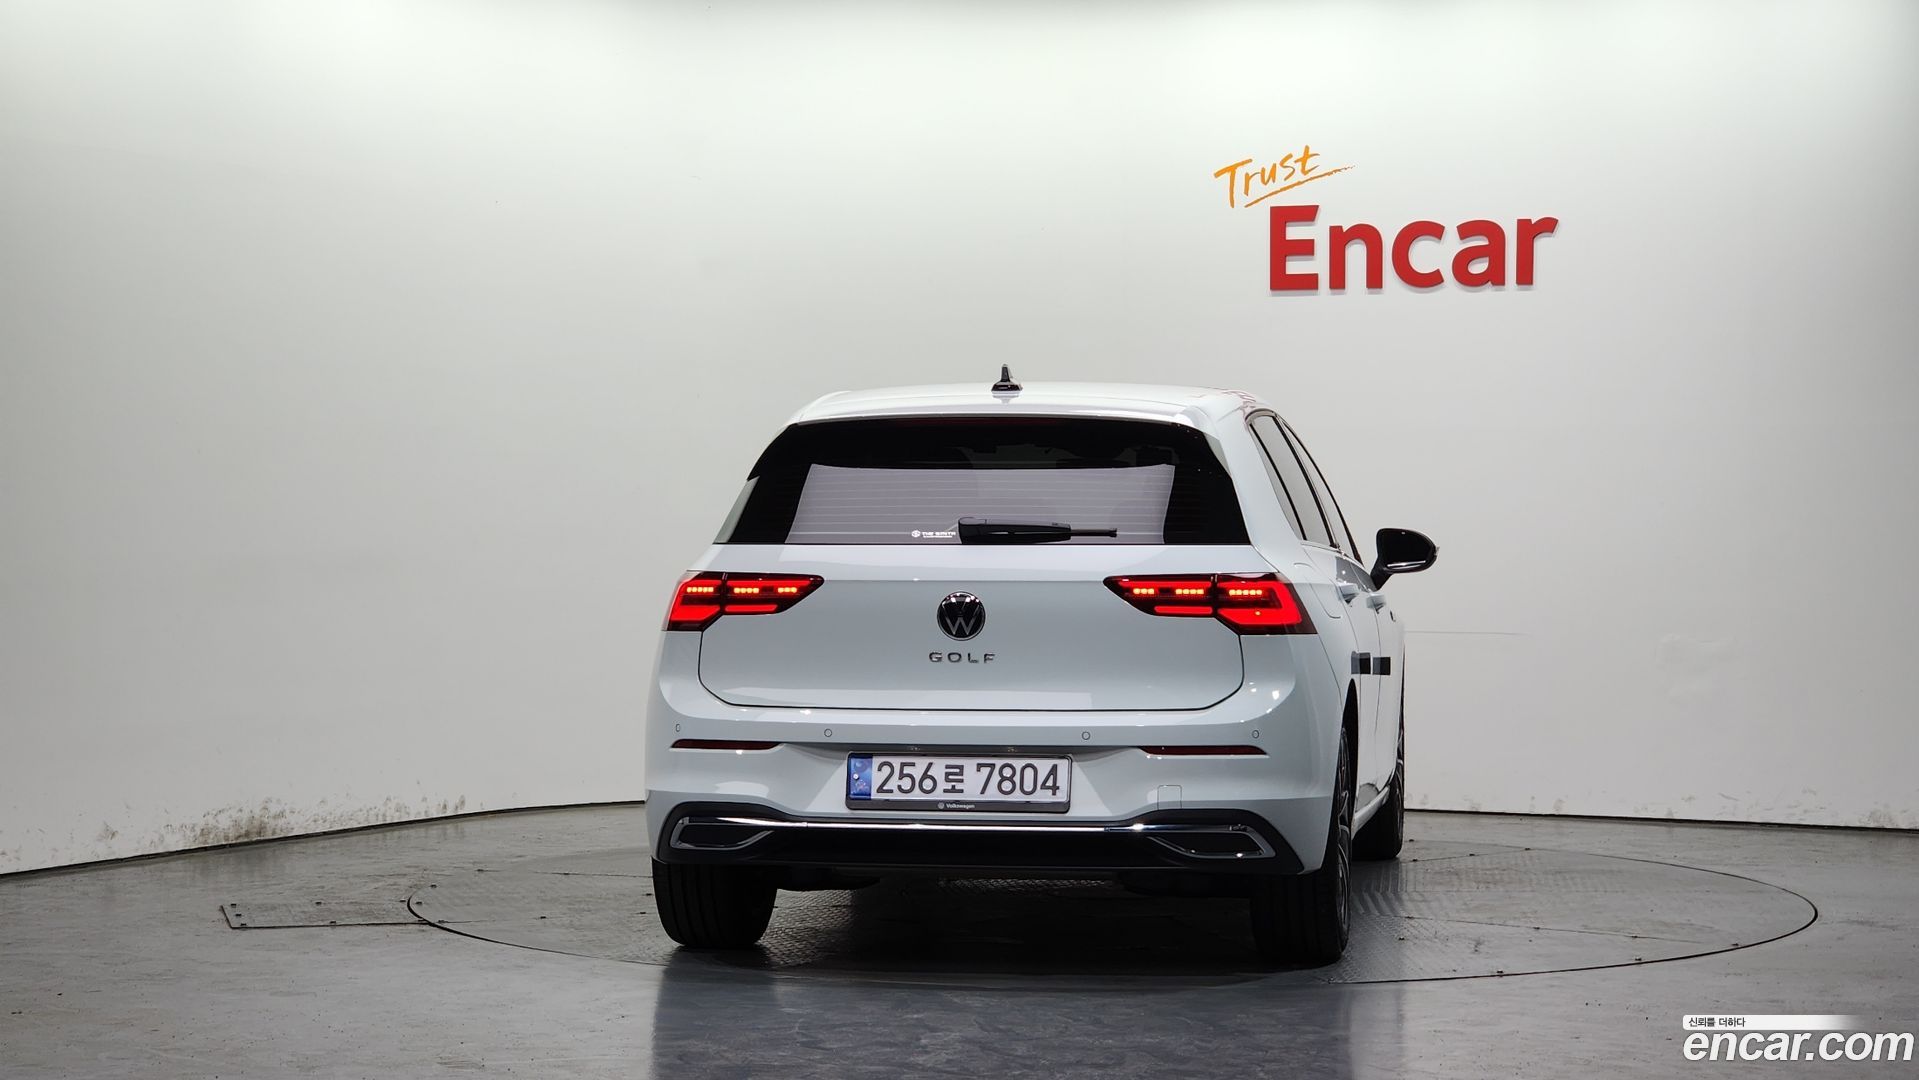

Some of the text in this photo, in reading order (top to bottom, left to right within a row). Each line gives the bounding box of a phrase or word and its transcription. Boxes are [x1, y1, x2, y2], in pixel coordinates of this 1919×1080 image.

[1214, 145, 1320, 208] Trust
[1270, 205, 1559, 291] Encar
[929, 651, 996, 664] GOLF
[876, 761, 1060, 796] 256로 7804
